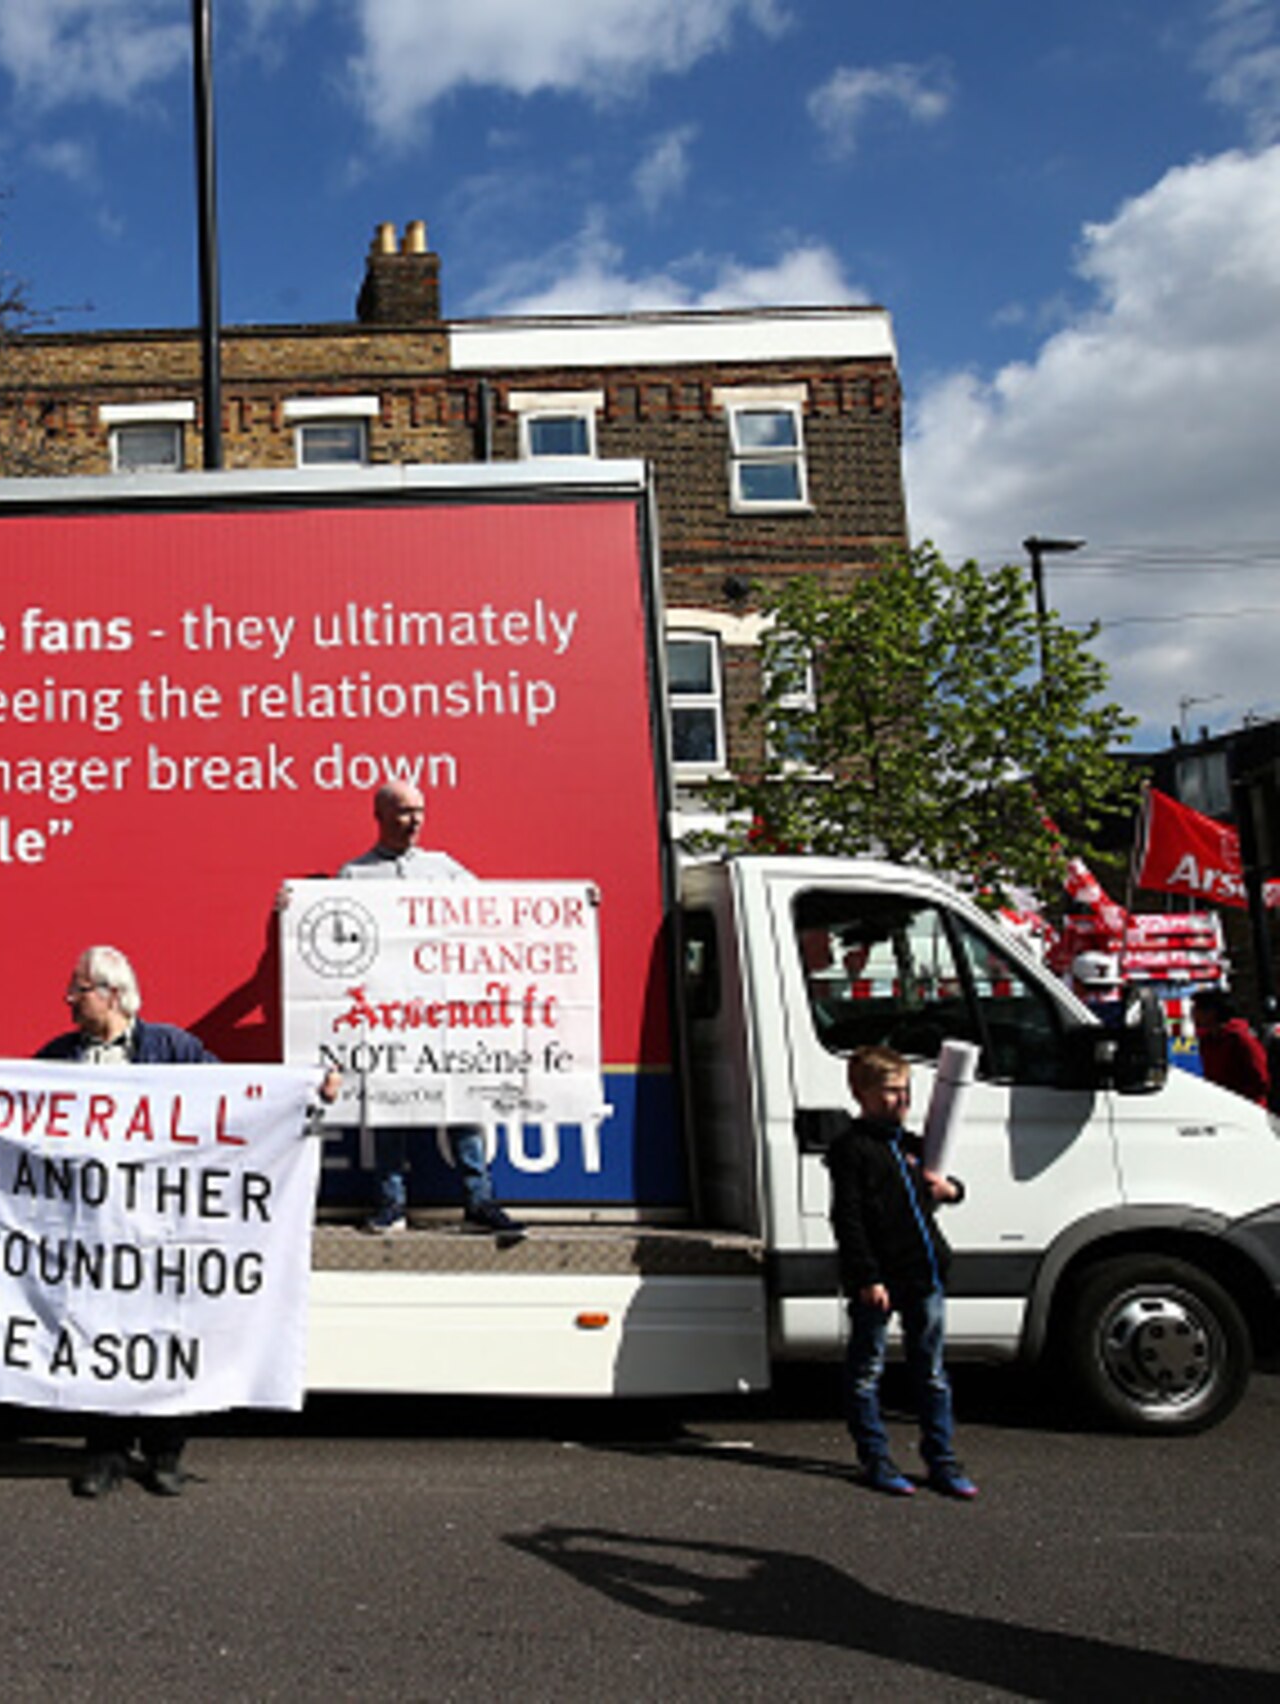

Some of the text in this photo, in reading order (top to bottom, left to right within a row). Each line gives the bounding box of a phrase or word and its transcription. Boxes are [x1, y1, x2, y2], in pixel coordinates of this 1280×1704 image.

[21, 607, 133, 653] fans
[181, 604, 295, 659] they
[314, 598, 578, 655] ultimately
[138, 675, 222, 721] the
[240, 669, 556, 726] relationship
[148, 743, 298, 790] break
[313, 743, 457, 789] down
[398, 896, 585, 928] TIME FOR
[412, 942, 577, 975] CHANGE
[319, 1044, 406, 1077] NOT
[11, 1149, 272, 1222] ANOTHER
